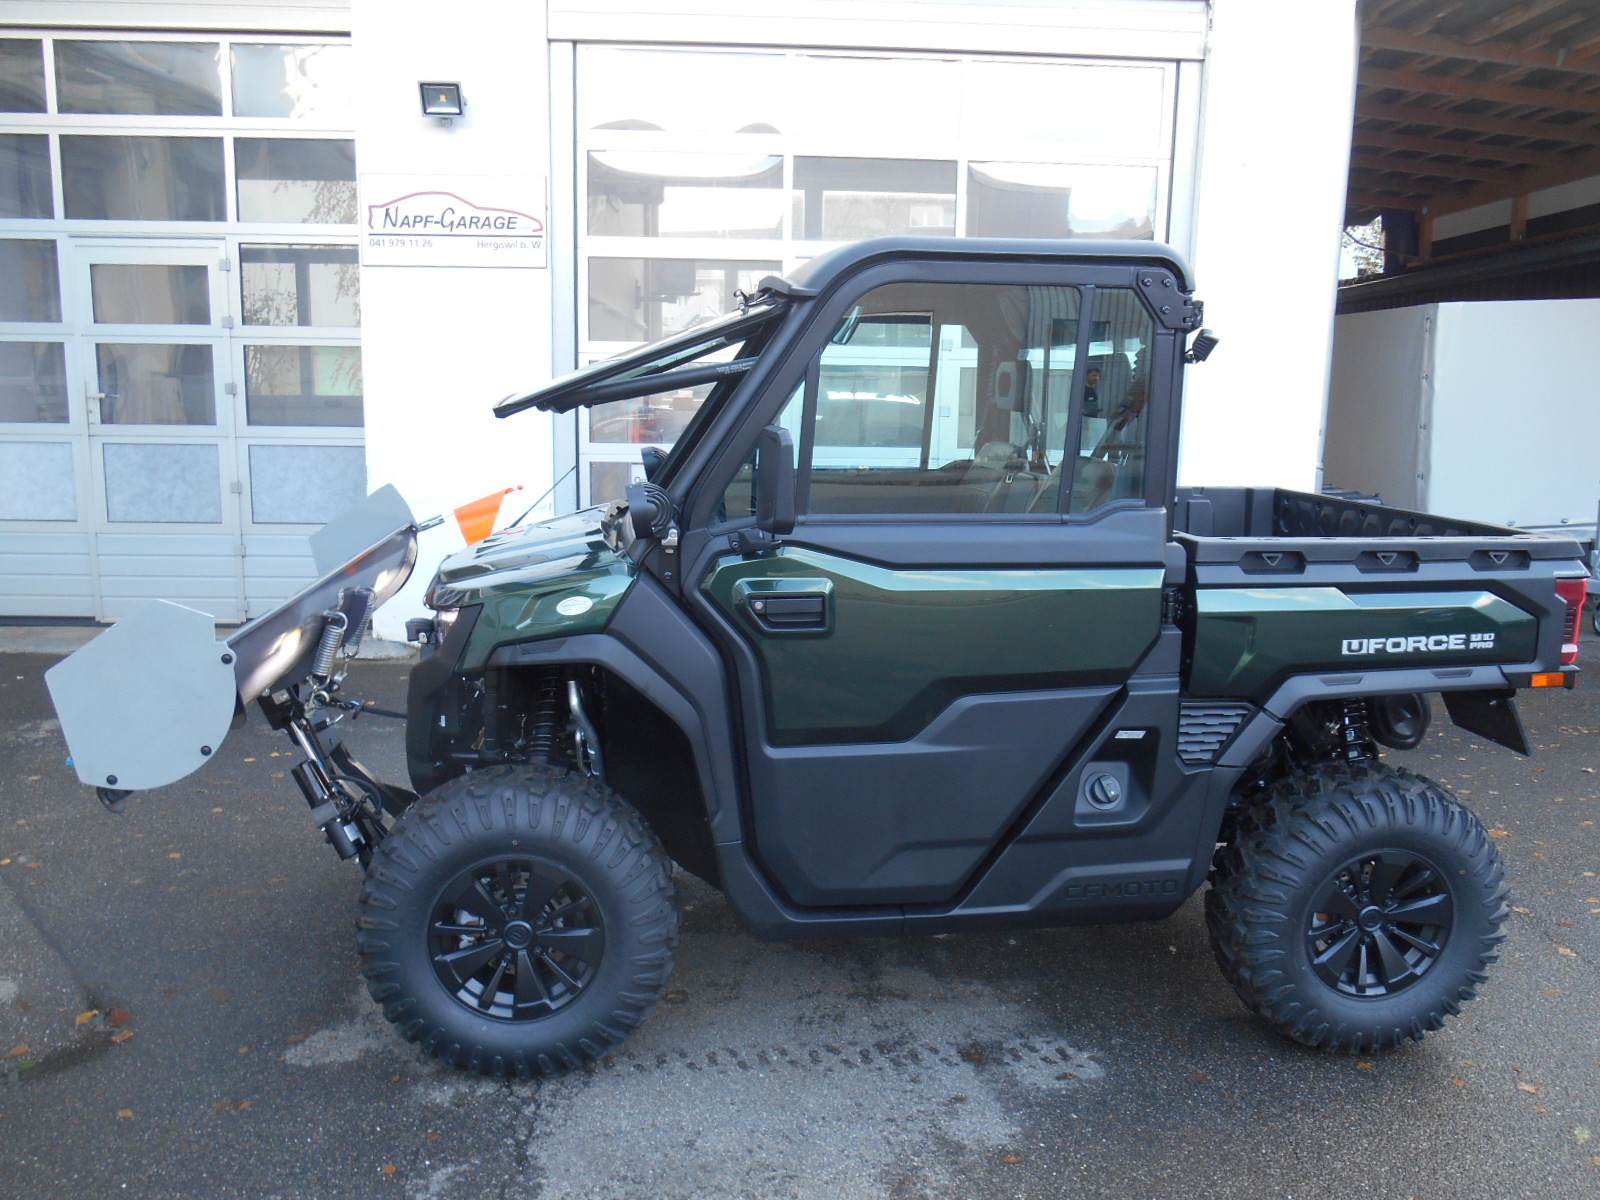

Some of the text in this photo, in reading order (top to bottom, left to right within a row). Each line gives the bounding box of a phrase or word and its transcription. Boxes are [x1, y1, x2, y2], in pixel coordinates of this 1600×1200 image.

[383, 206, 518, 233] NAPF-GARAGE
[369, 238, 433, 248] 041 979 11 26
[476, 240, 518, 251] Hergiswil
[520, 241, 529, 249] b.
[1341, 633, 1467, 655] UFORCE
[1469, 641, 1494, 649] PRO
[1064, 879, 1178, 900] CFMOTO
